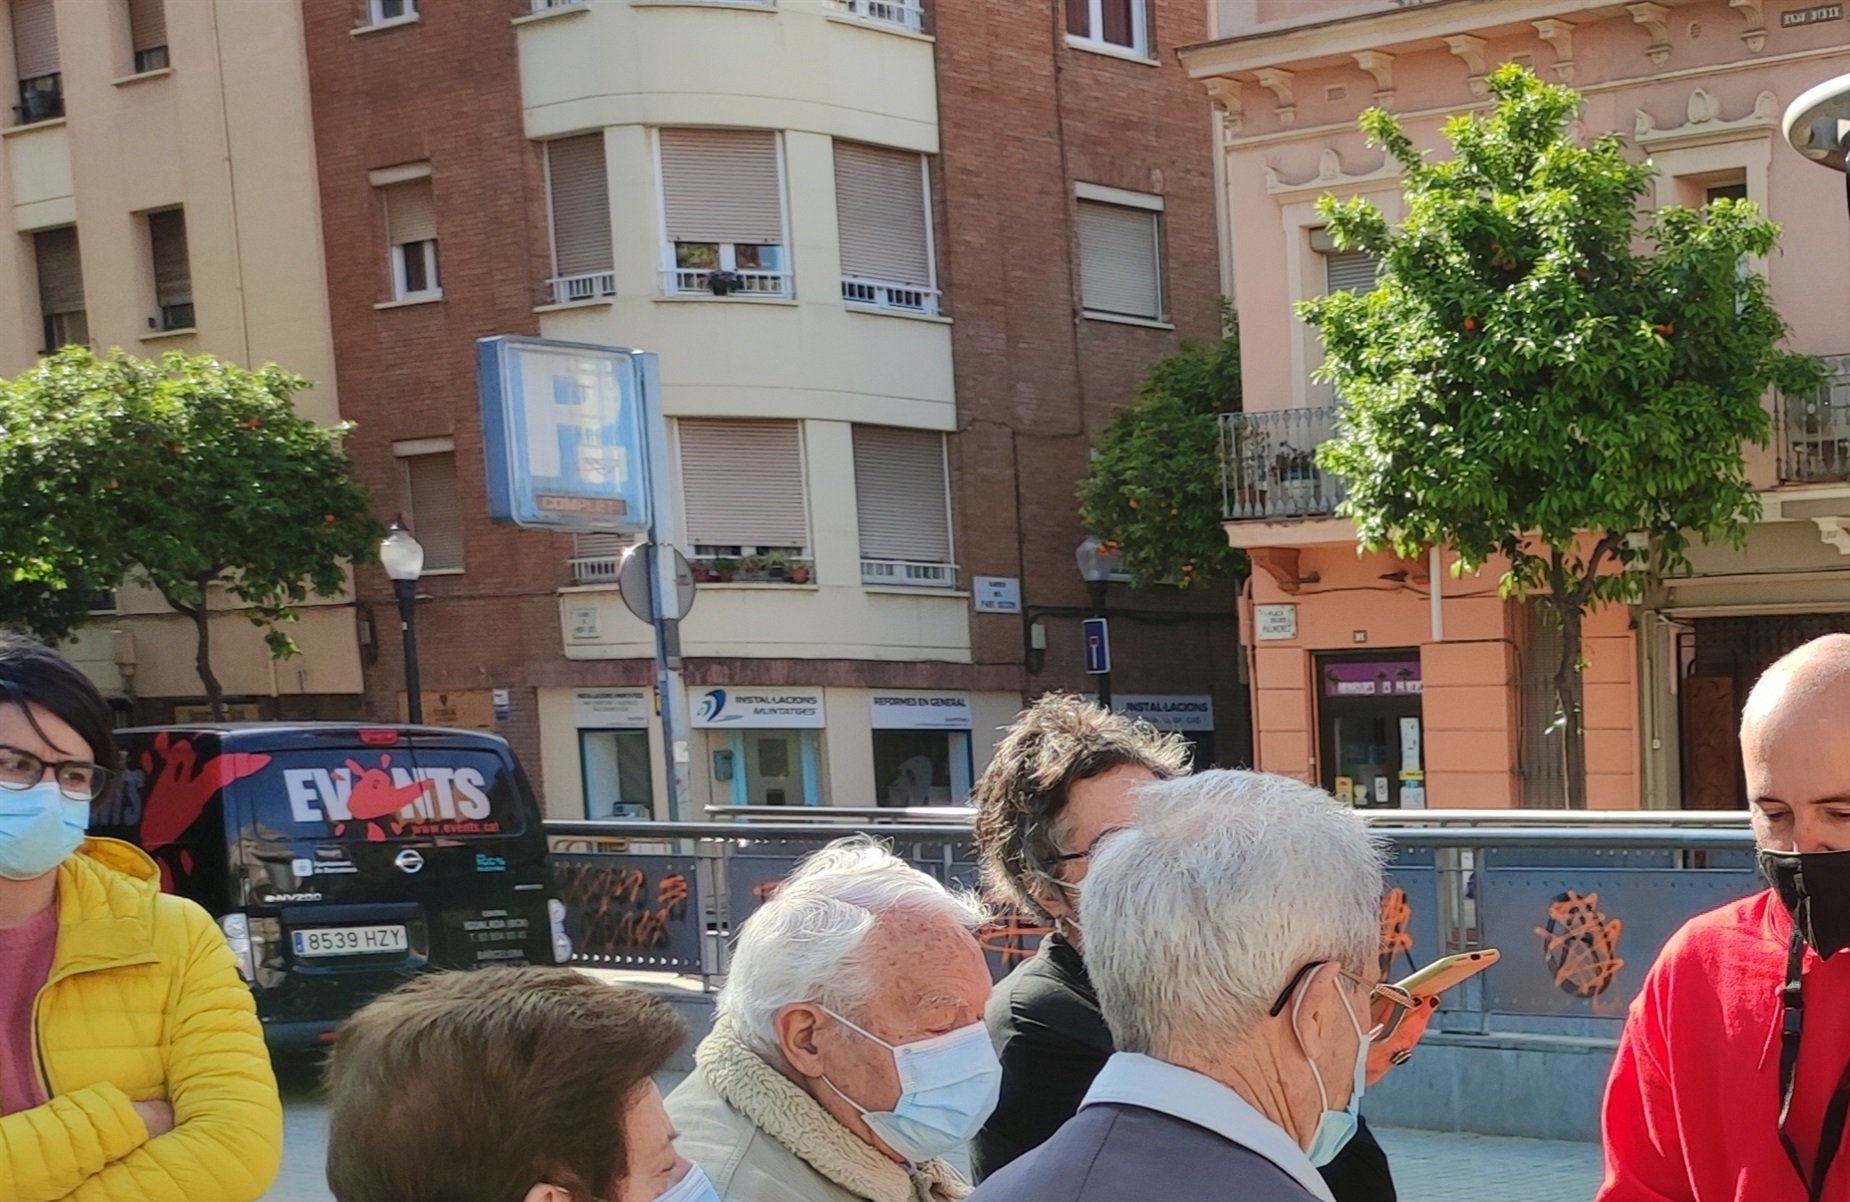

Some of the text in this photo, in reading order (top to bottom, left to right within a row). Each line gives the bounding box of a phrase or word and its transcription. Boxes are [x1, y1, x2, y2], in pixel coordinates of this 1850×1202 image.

[519, 350, 622, 478] P
[541, 496, 624, 514] COMPLET
[308, 929, 401, 950] 8539 HZY
